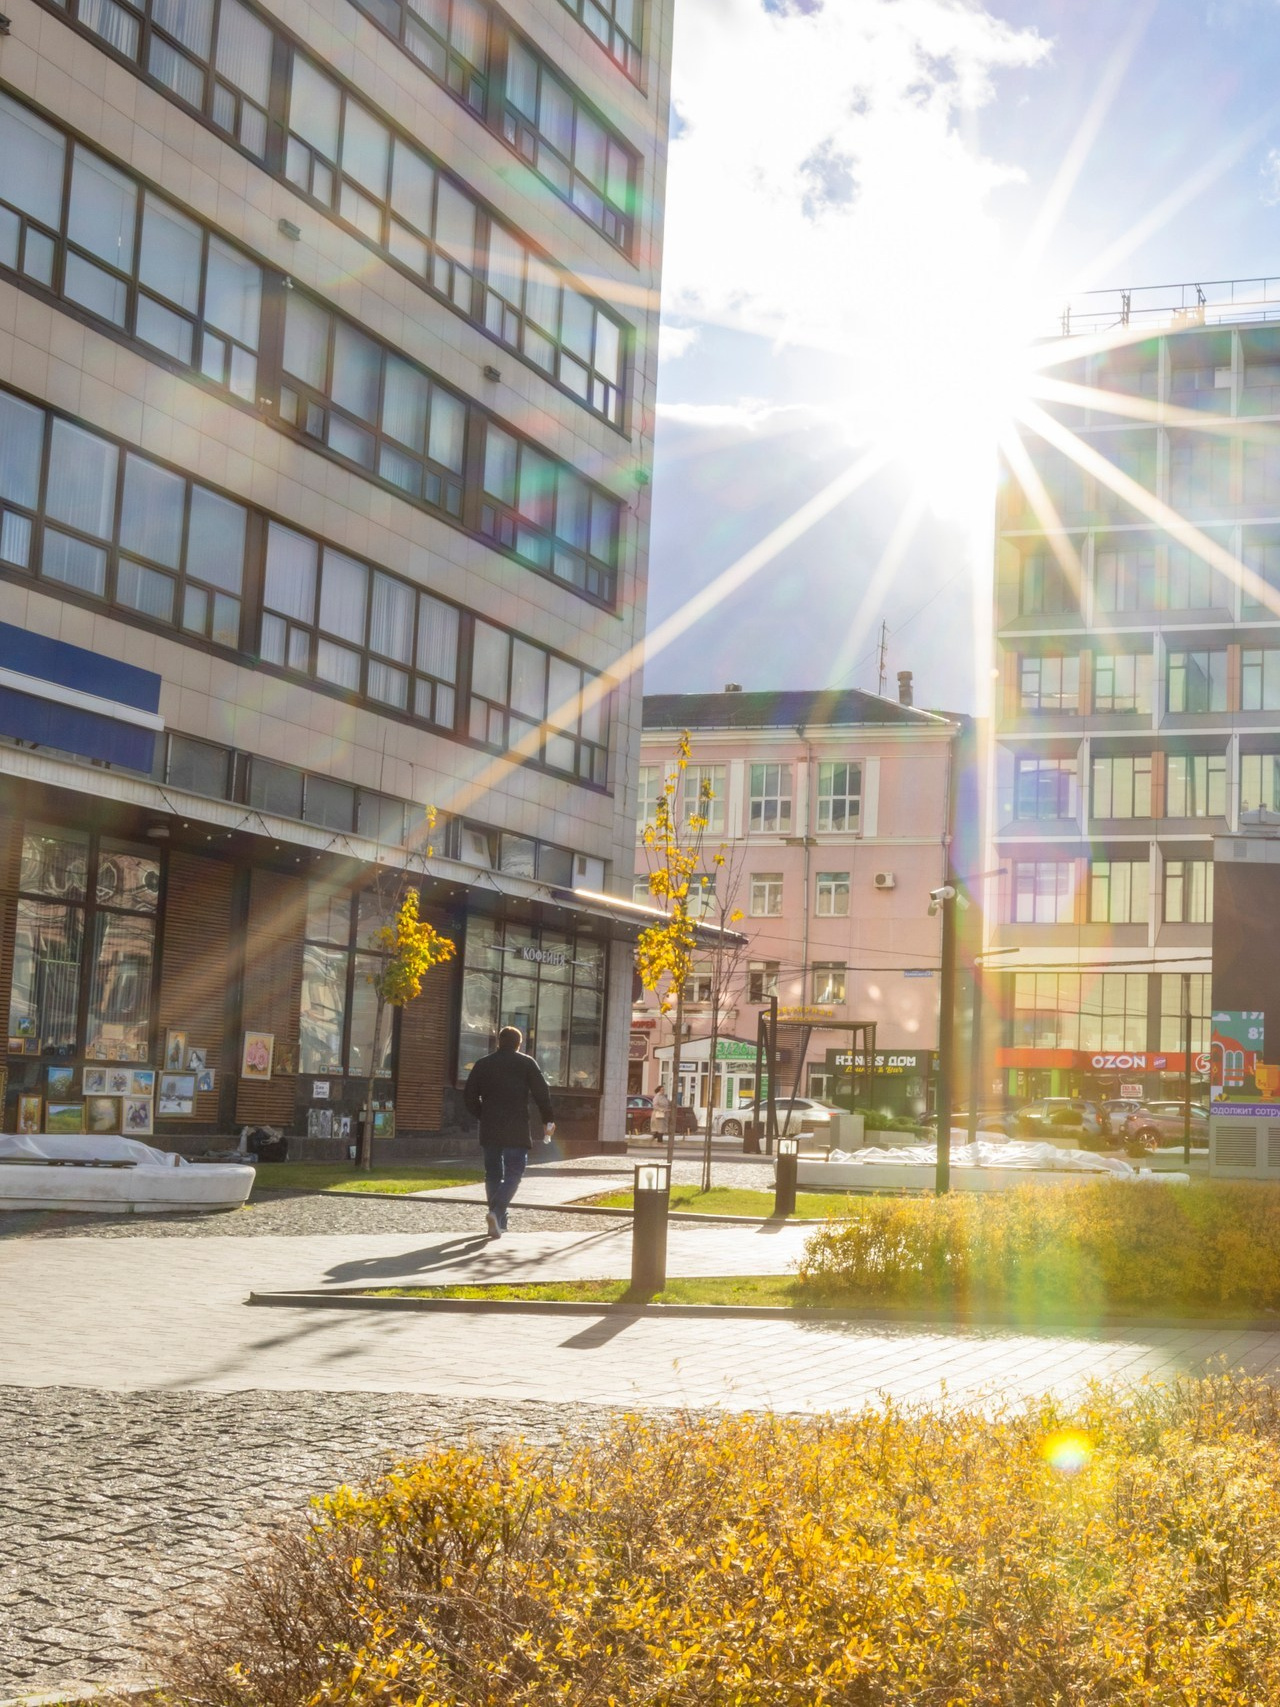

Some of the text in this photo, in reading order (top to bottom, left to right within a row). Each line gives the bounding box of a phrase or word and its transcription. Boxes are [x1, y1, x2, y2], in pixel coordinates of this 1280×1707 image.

[523, 947, 565, 966] КОФЕЙНЯ
[1092, 1055, 1145, 1068] OZON
[1211, 1106, 1252, 1116] одолжит
